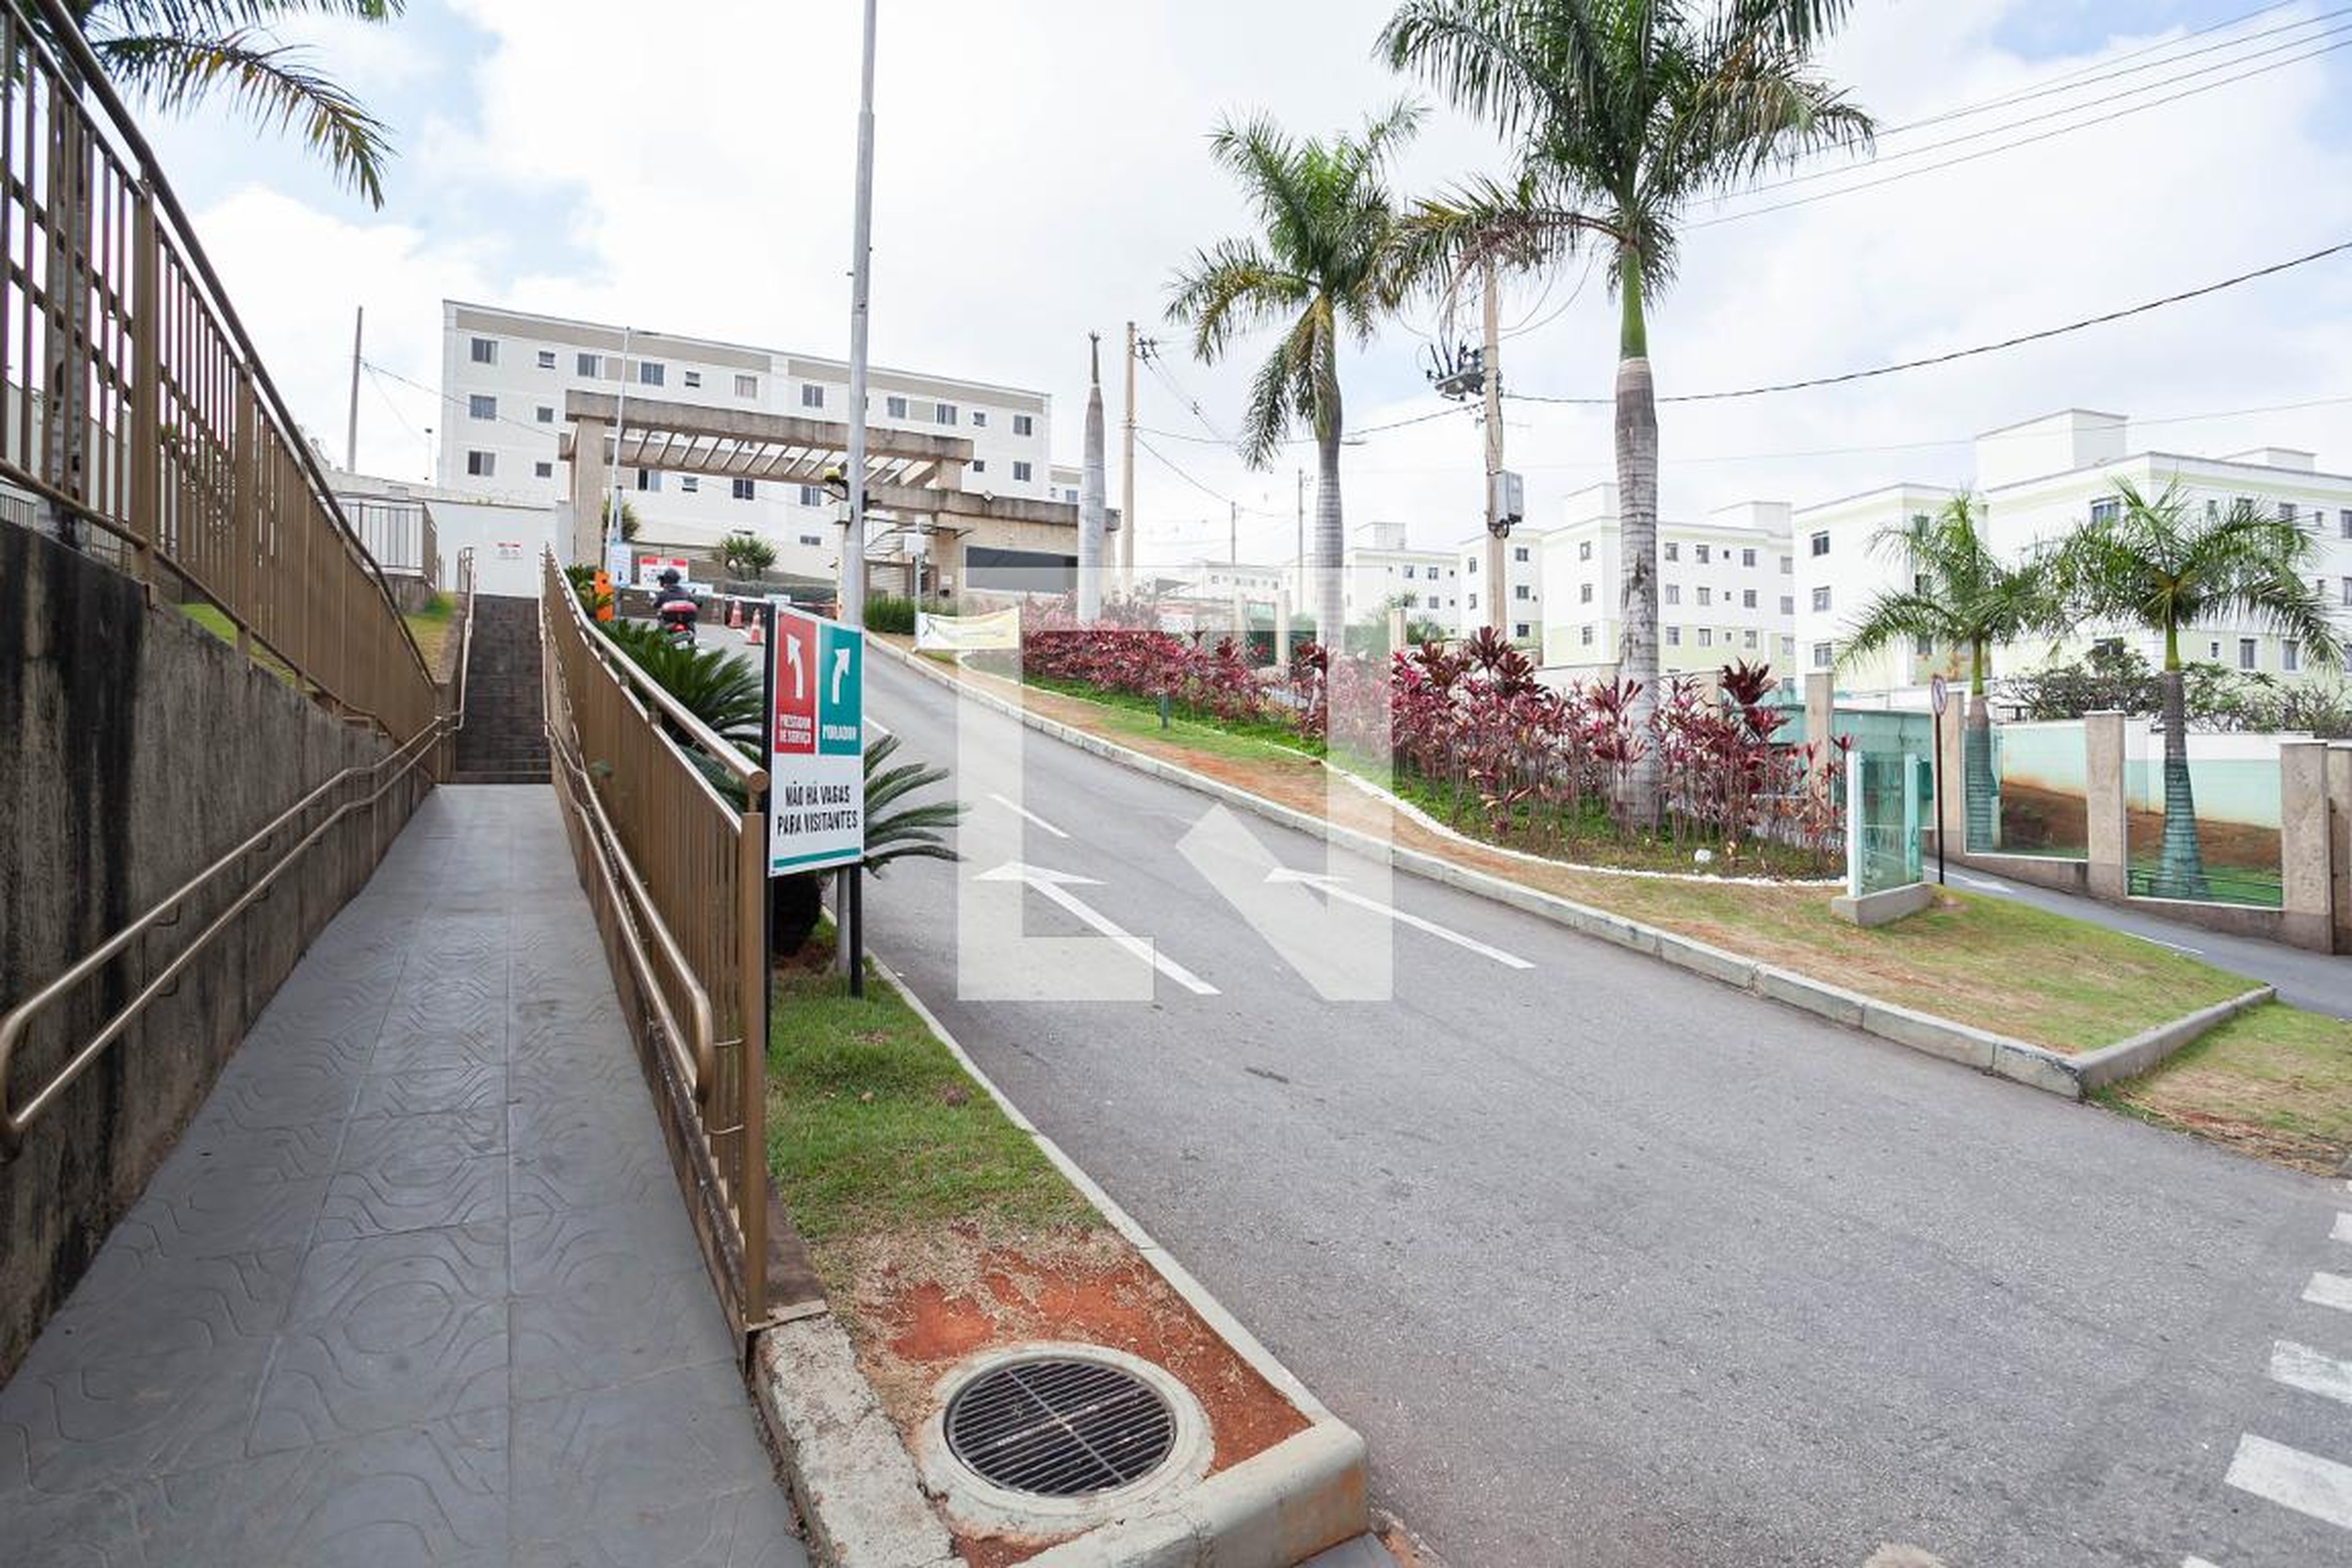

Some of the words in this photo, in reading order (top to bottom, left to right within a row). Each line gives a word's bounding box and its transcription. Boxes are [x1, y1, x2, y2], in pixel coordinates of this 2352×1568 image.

[786, 781, 803, 806] NÃO
[806, 782, 818, 805] HÁ
[820, 785, 850, 804] VAGAS
[777, 814, 802, 836] PARA
[804, 810, 858, 833] VISITANTES
